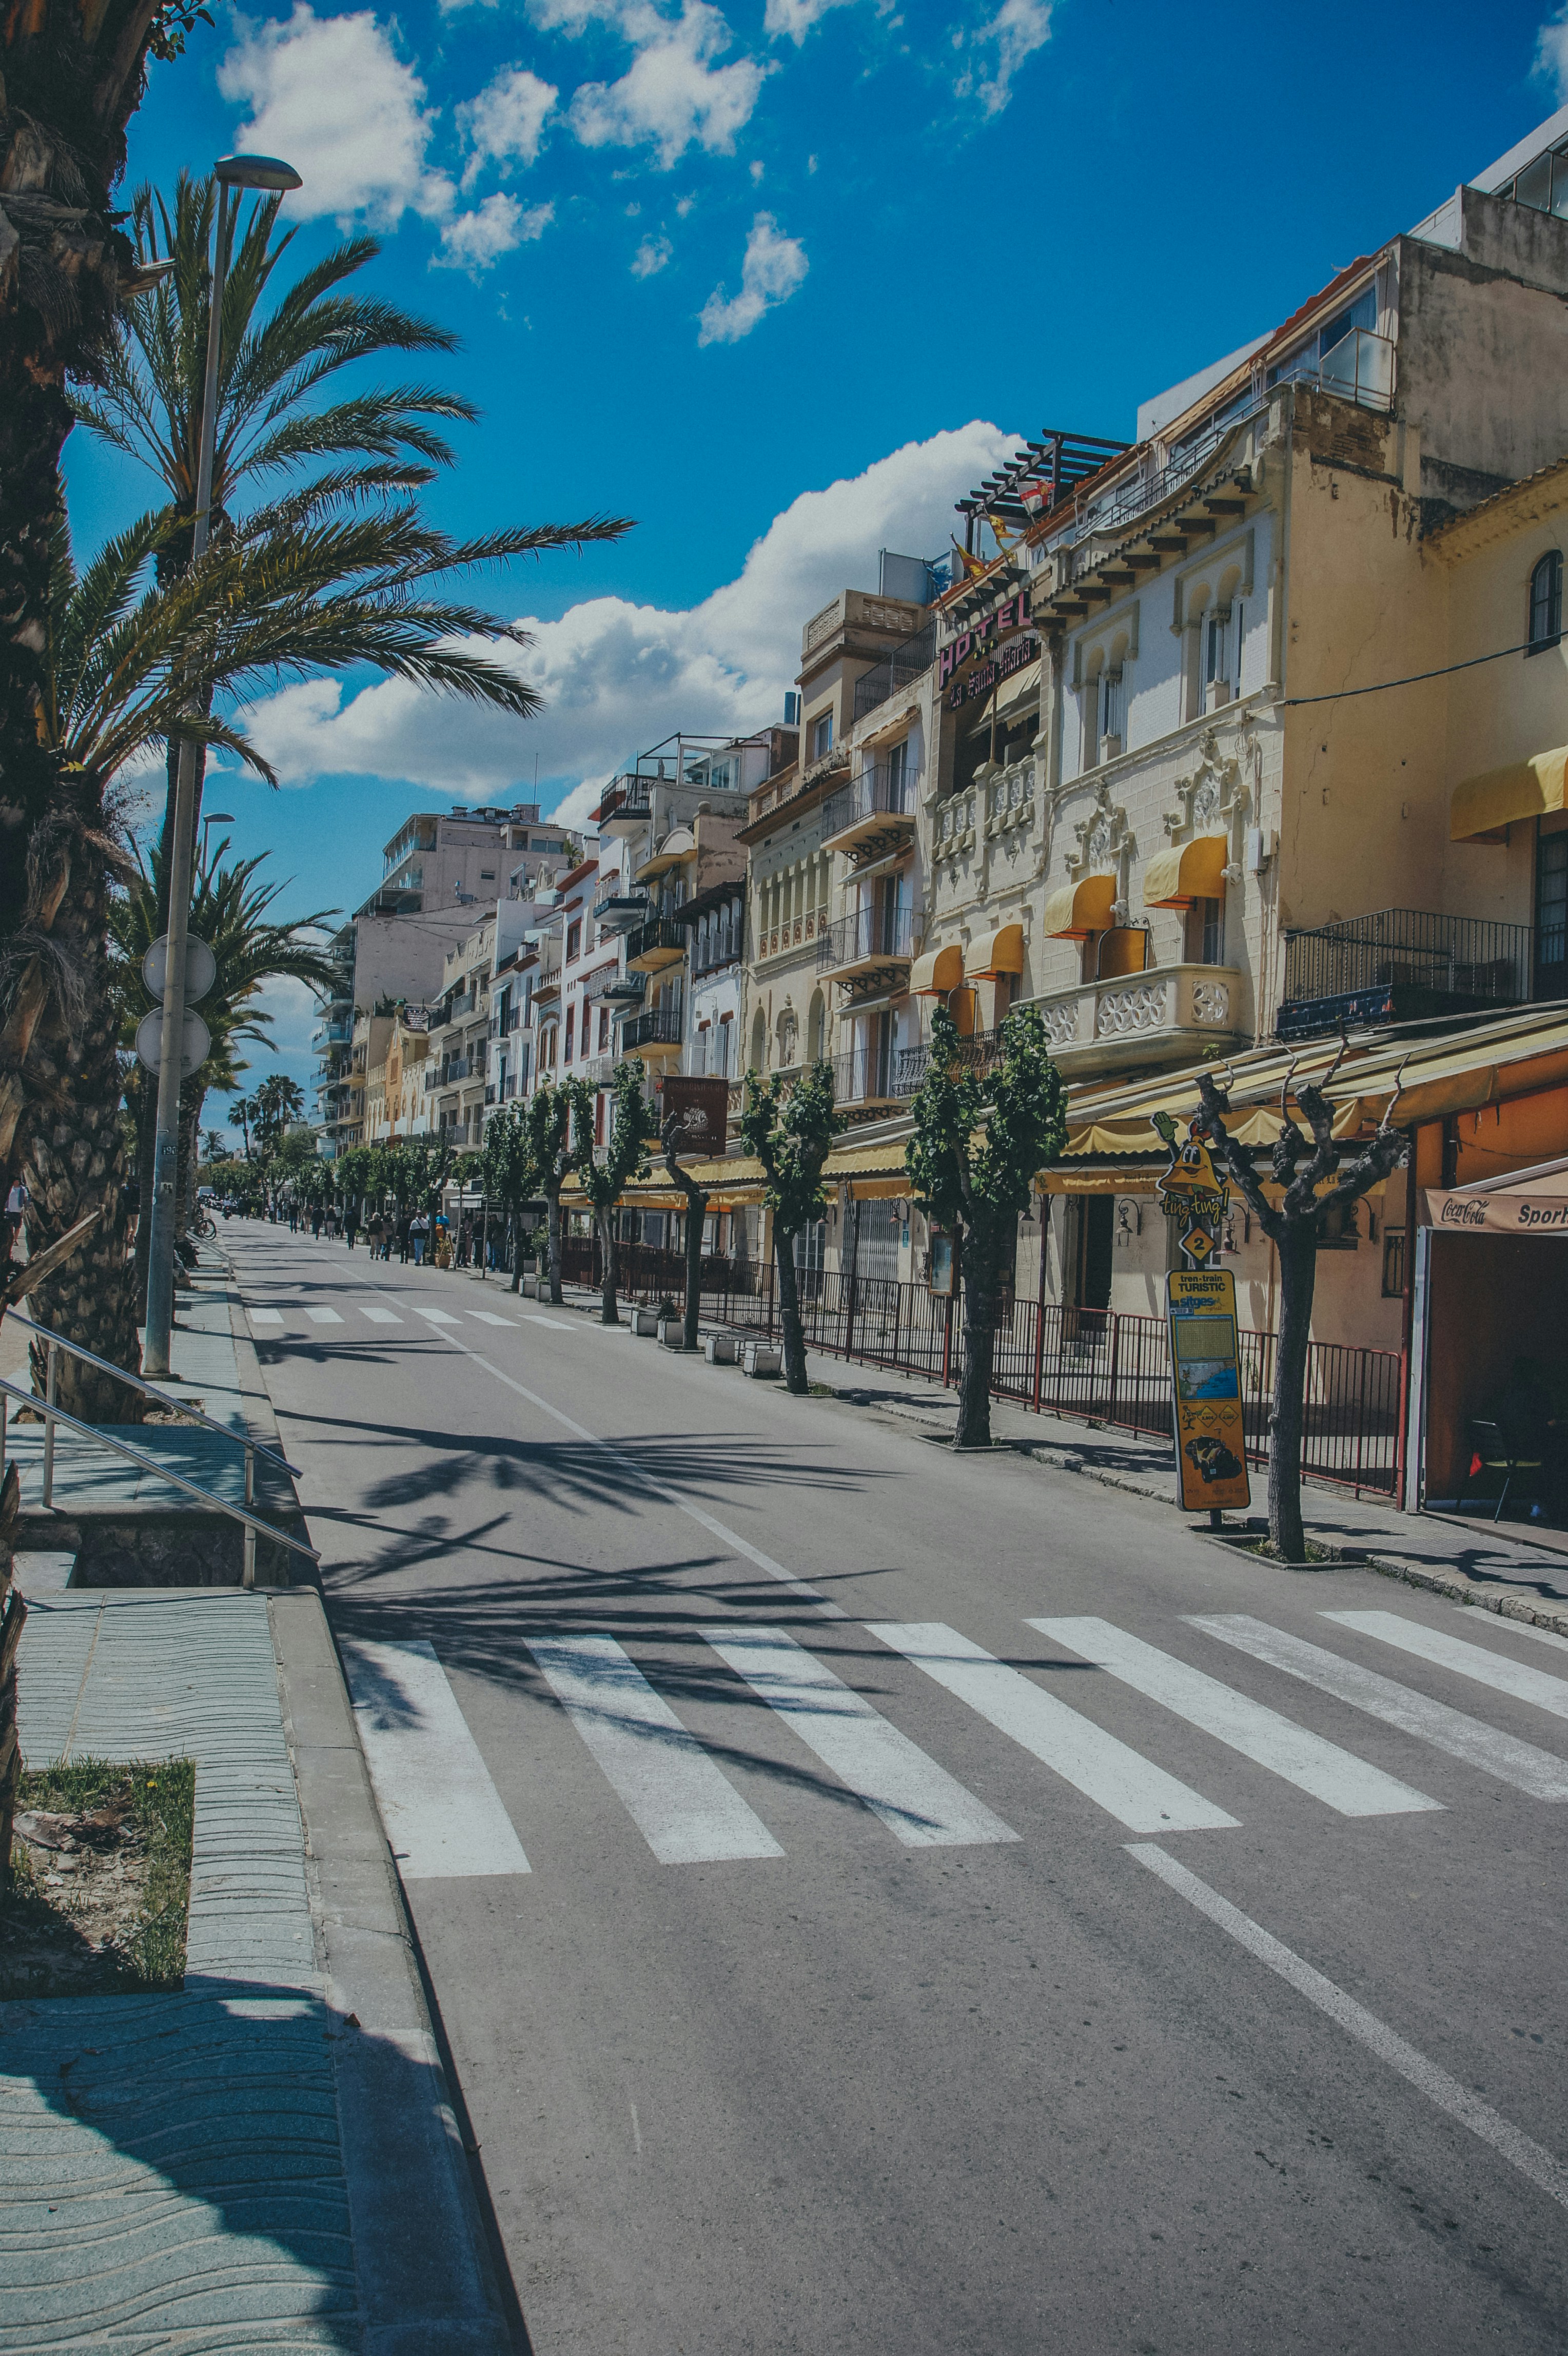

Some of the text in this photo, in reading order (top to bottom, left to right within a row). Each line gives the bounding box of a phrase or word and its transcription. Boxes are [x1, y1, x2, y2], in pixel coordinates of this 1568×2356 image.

[939, 592, 1032, 691] HOTEL
[968, 662, 995, 697] Santa
[1441, 1197, 1489, 1225] Coca-Cola
[1518, 1204, 1568, 1227] Sport
[1194, 1238, 1205, 1250] 2
[1178, 1283, 1225, 1292] TURISTIC
[1180, 1295, 1214, 1309] sitges
